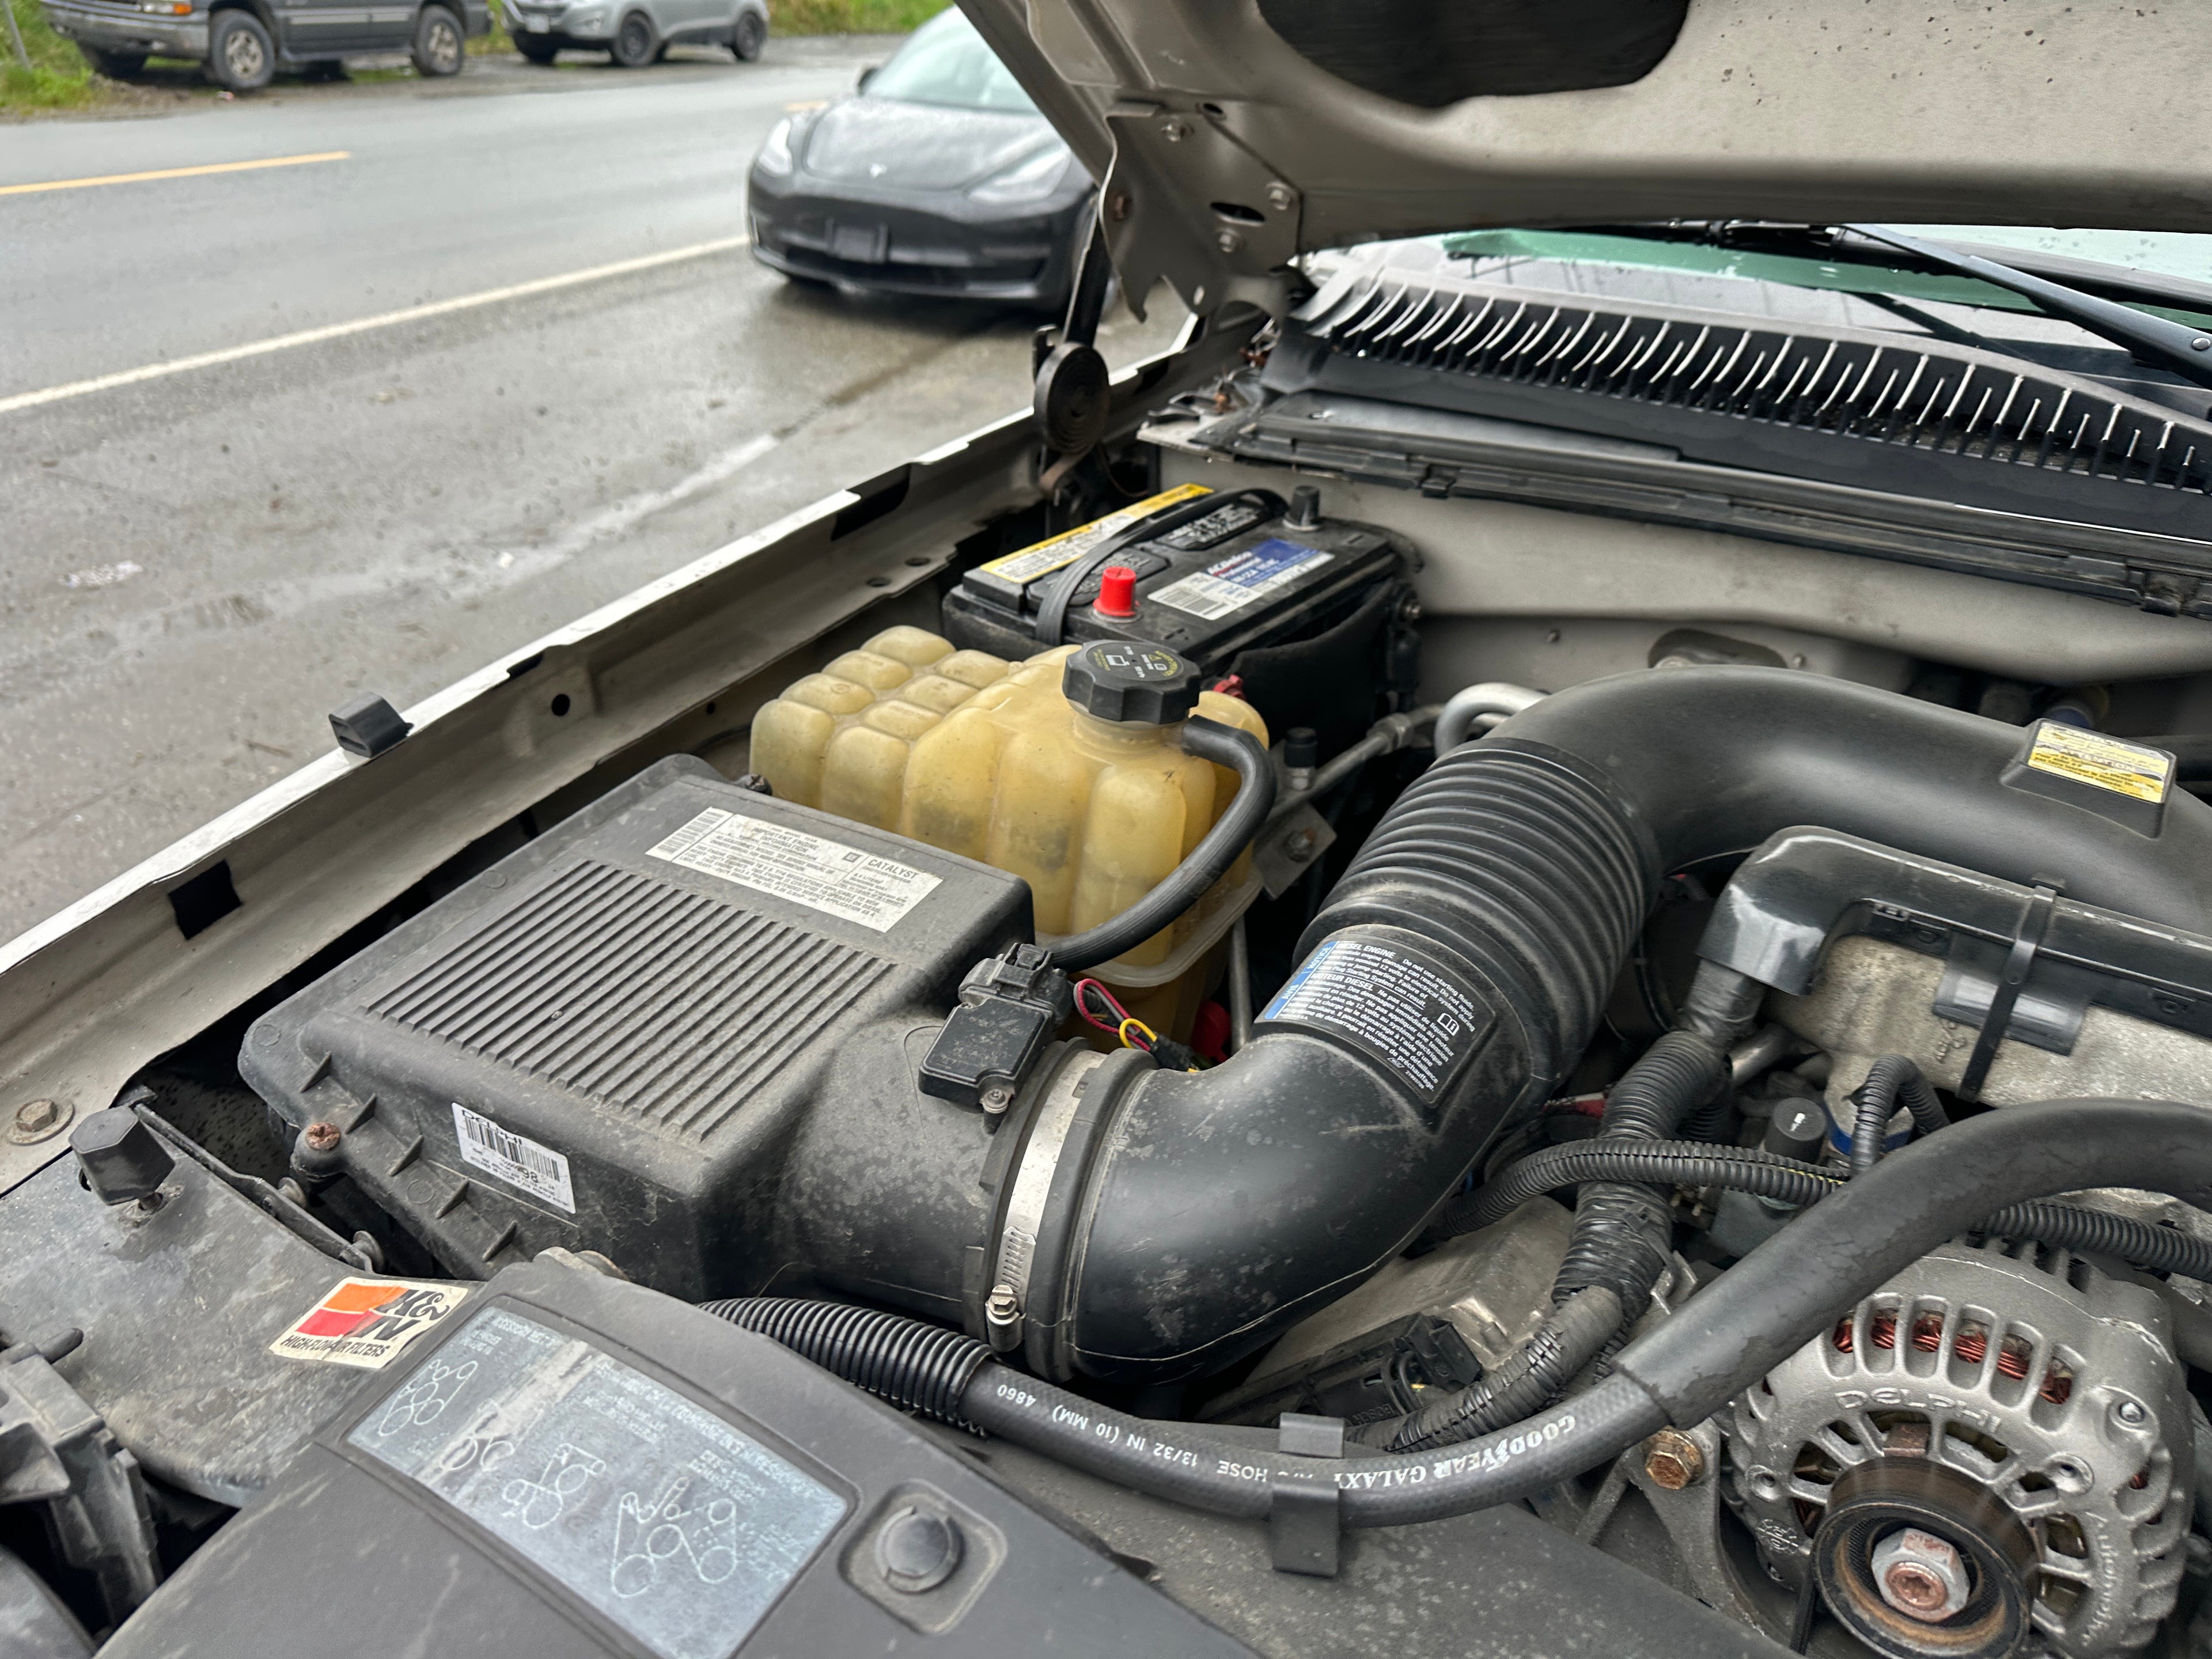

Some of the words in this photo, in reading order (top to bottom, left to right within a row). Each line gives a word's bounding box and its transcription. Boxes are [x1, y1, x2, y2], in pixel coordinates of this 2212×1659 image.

[752, 827, 792, 841] IMPORTANT
[792, 839, 819, 850] ENGINE
[760, 836, 808, 852] INFORMATION
[868, 859, 918, 878] CATALYST
[802, 891, 824, 899] SERVICE
[825, 898, 861, 911] APPLICATION
[823, 886, 856, 898] APPLICABLE
[827, 893, 852, 902] OPERATE
[862, 904, 882, 912] DIESEL
[1306, 946, 1332, 969] NOTICE
[1363, 945, 1396, 959] ENGINE
[1412, 964, 1424, 972] not
[1423, 970, 1435, 979] use
[1435, 978, 1459, 996] starting
[1281, 984, 1300, 999] AVIS
[1347, 968, 1370, 979] Starting
[1370, 975, 1395, 988] System
[1394, 987, 1407, 995] can
[1406, 993, 1426, 1008] result.
[1354, 957, 1379, 967] nominal
[1388, 968, 1404, 977] volts
[1411, 979, 1439, 998] electrical
[1438, 997, 1459, 1015] system
[1458, 1013, 1475, 1032] during
[1361, 953, 1382, 961] engine
[1382, 959, 1408, 971] damage
[1408, 969, 1420, 978] can
[1421, 976, 1439, 990] result.
[1440, 988, 1449, 997] Do
[1449, 995, 1459, 1005] not
[1459, 1005, 1474, 1020] apply
[1397, 979, 1420, 994] Failure
[1311, 973, 1345, 982] MOTEUR
[1344, 976, 1374, 991] DIESEL
[1378, 990, 1388, 998] Ne
[1387, 995, 1400, 1004] pas
[1400, 1002, 1422, 1018] utiliser
[1421, 1017, 1430, 1025] de
[1430, 1022, 1449, 1041] liquide
[1322, 1001, 1344, 1010] charge
[1360, 1014, 1395, 1035] démarrage
[1399, 1037, 1416, 1052] l'aide
[1416, 1051, 1433, 1067] d'une
[1324, 1015, 1359, 1032] démarrage
[1364, 1032, 1389, 1050] bougies
[1389, 1048, 1398, 1056] de
[1360, 991, 1395, 1010] dommages
[1395, 1007, 1427, 1032] immédiats
[1434, 1037, 1455, 1056] moteur
[1366, 999, 1376, 1007] Ne
[1375, 1006, 1388, 1014] pas
[1388, 1011, 1418, 1033] appliquer
[1416, 1032, 1429, 1043] une
[1429, 1041, 1449, 1062] tension
[1341, 1013, 1367, 1028] pourrait
[1375, 1031, 1399, 1047] résulter
[1398, 1046, 1410, 1056] une
[1410, 1055, 1438, 1084] défaillance
[1365, 1007, 1380, 1018] volts
[1415, 1040, 1442, 1066] électrique
[348, 1342, 391, 1357] FILTERS
[997, 1384, 1036, 1407] 4860
[1052, 1404, 1089, 1430] MM)
[1836, 1388, 2001, 1433] DELPHI
[1096, 1423, 1119, 1443] (10
[1127, 1434, 1146, 1451] IN
[1153, 1442, 1198, 1467] 13/32
[1433, 1415, 1576, 1479] GOODYEAR
[1217, 1460, 1267, 1482] HOSE
